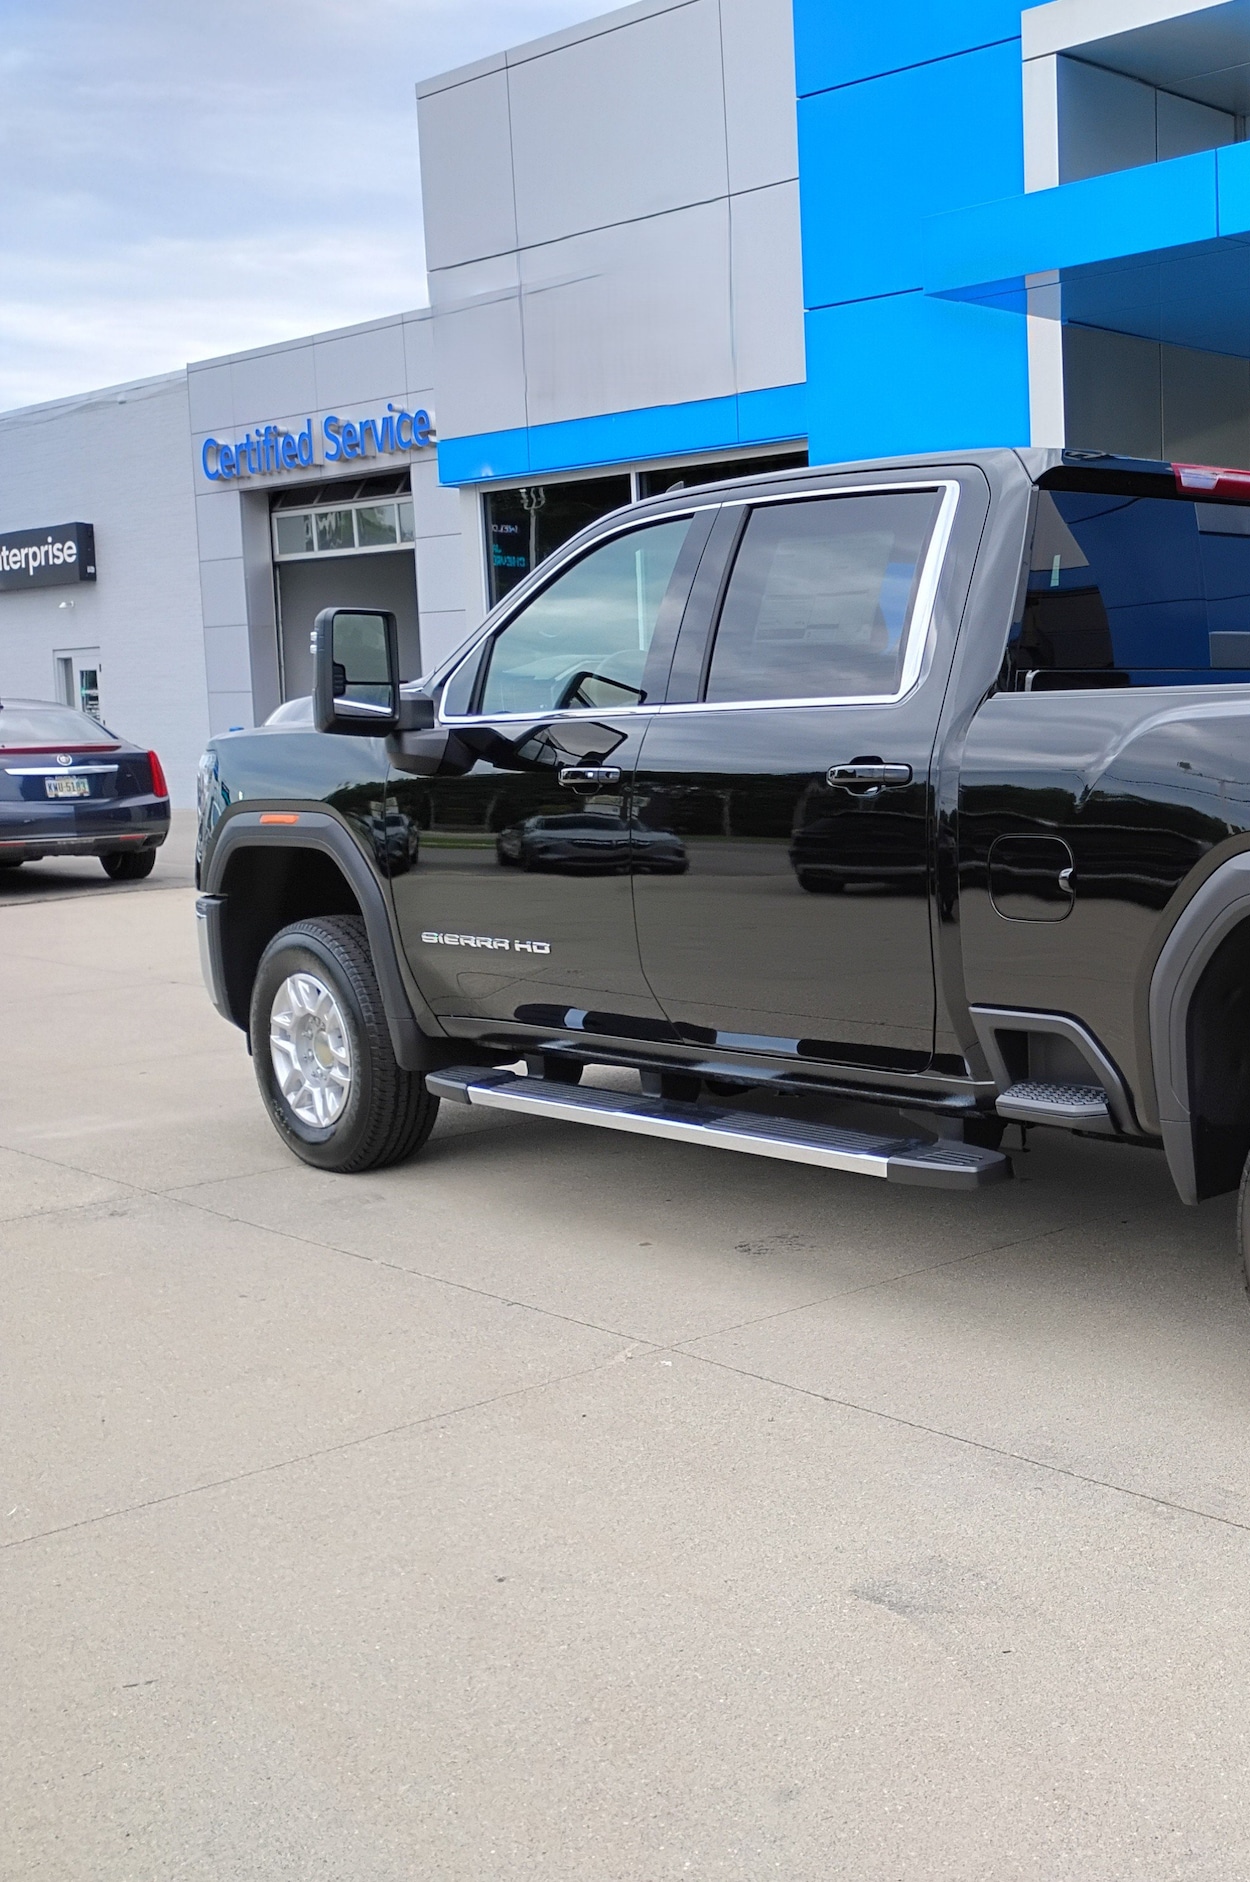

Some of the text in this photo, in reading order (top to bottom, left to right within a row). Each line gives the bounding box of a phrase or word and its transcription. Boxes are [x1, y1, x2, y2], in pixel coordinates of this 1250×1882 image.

[202, 403, 431, 481] Certified Service
[421, 931, 552, 955] SIERRA HD
